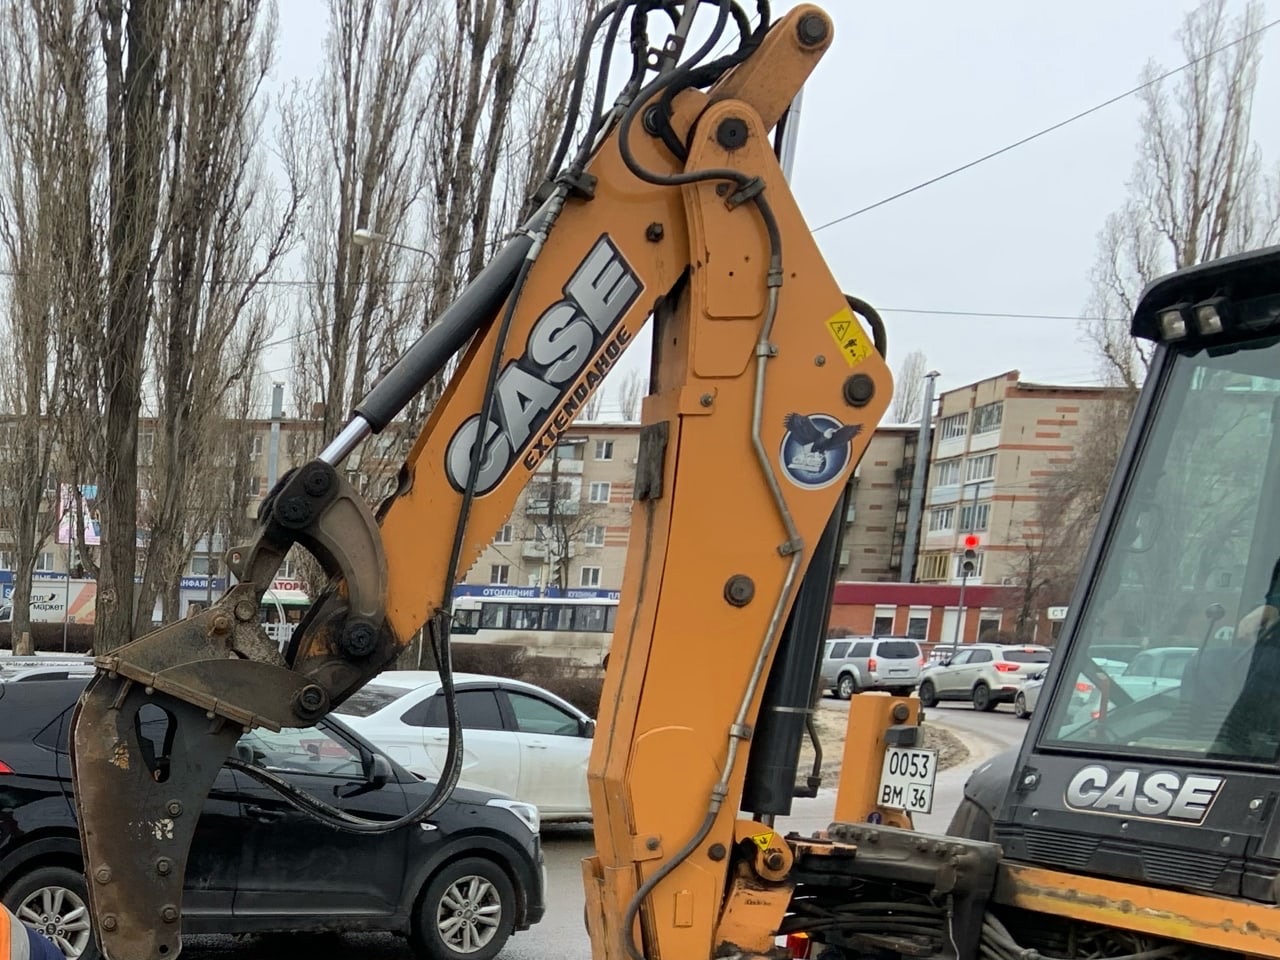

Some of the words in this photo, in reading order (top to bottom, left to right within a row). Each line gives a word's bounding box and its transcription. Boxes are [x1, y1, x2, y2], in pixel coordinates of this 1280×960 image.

[446, 236, 641, 494] CASE
[523, 325, 632, 471] EXTENDAHOE
[482, 588, 535, 597] ОТОПЛЕНИЕ
[33, 604, 64, 612] маркет
[889, 751, 930, 779] 0053
[910, 788, 926, 808] 36
[1066, 766, 1223, 821] CASE
